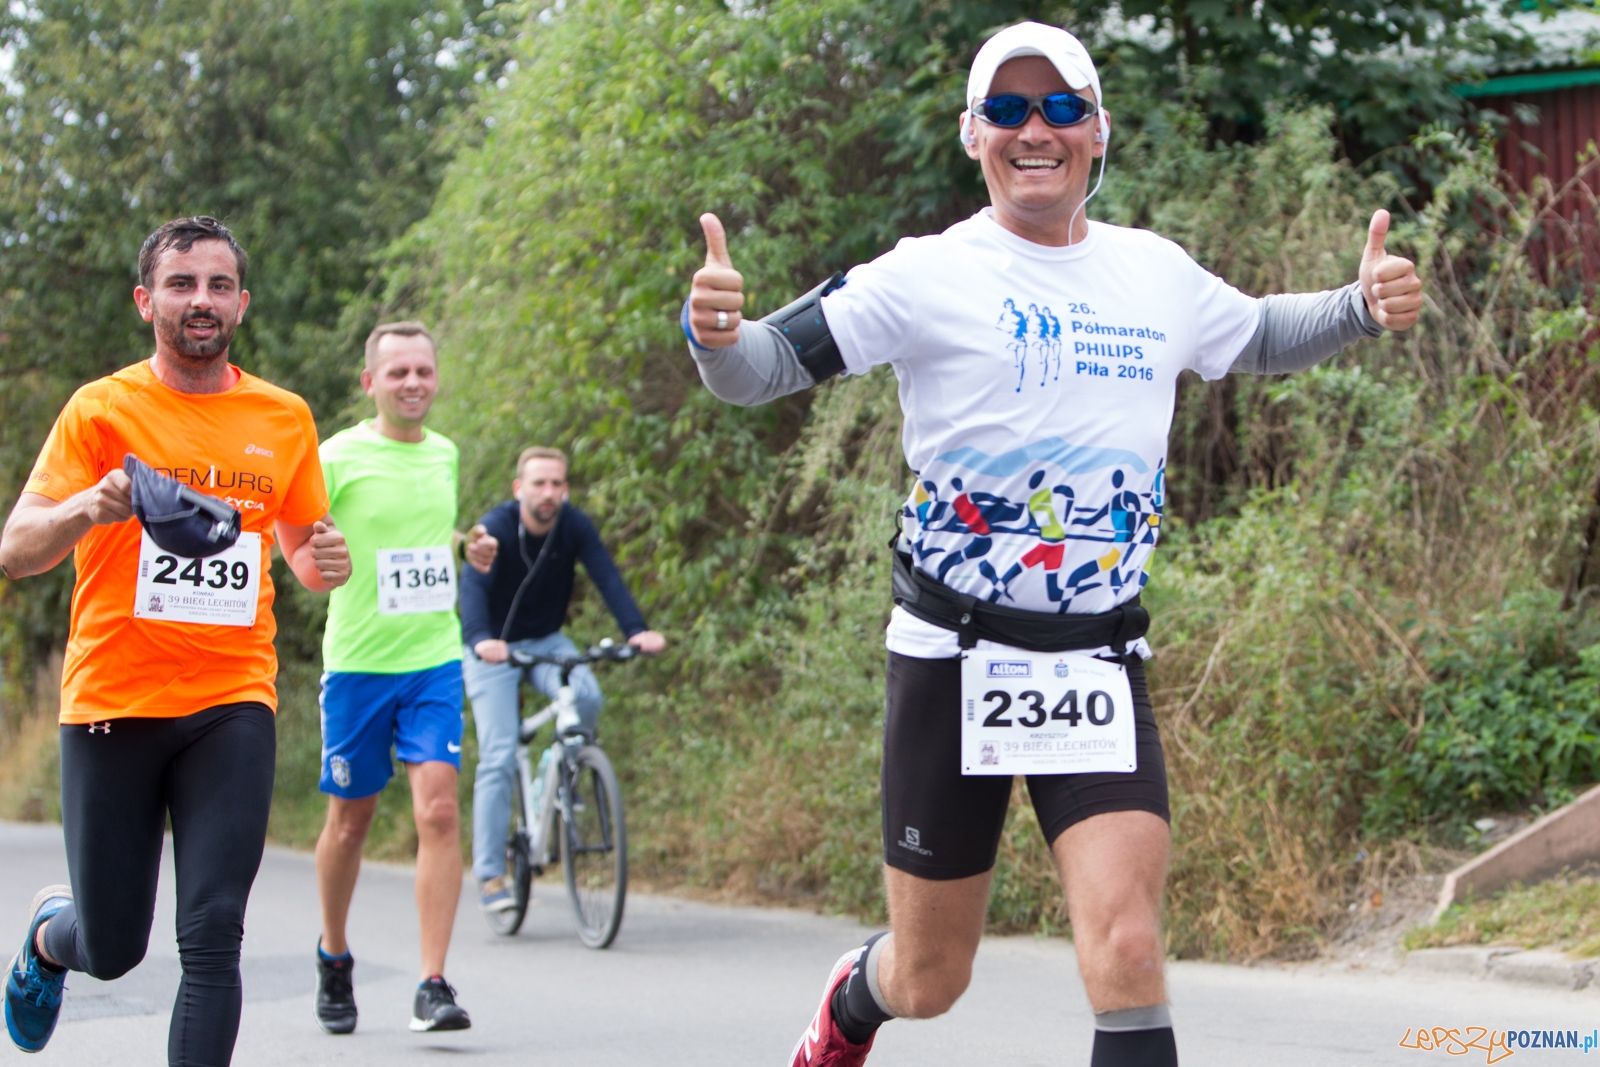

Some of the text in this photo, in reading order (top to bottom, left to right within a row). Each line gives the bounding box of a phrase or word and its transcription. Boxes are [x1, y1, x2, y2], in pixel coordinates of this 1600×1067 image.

[1068, 303, 1096, 314] 26.
[1071, 320, 1167, 343] Półmaraton
[1074, 341, 1144, 360] PHILIPS
[1076, 361, 1153, 381] Piła 2016
[152, 555, 249, 590] 2439
[389, 566, 449, 589] 1364
[167, 594, 181, 605] 39
[182, 596, 206, 606] BIEG
[207, 598, 249, 609] LECHITÓW
[982, 690, 1115, 727] 2340
[1003, 737, 1119, 753] 39 BIEG LECHITÓW
